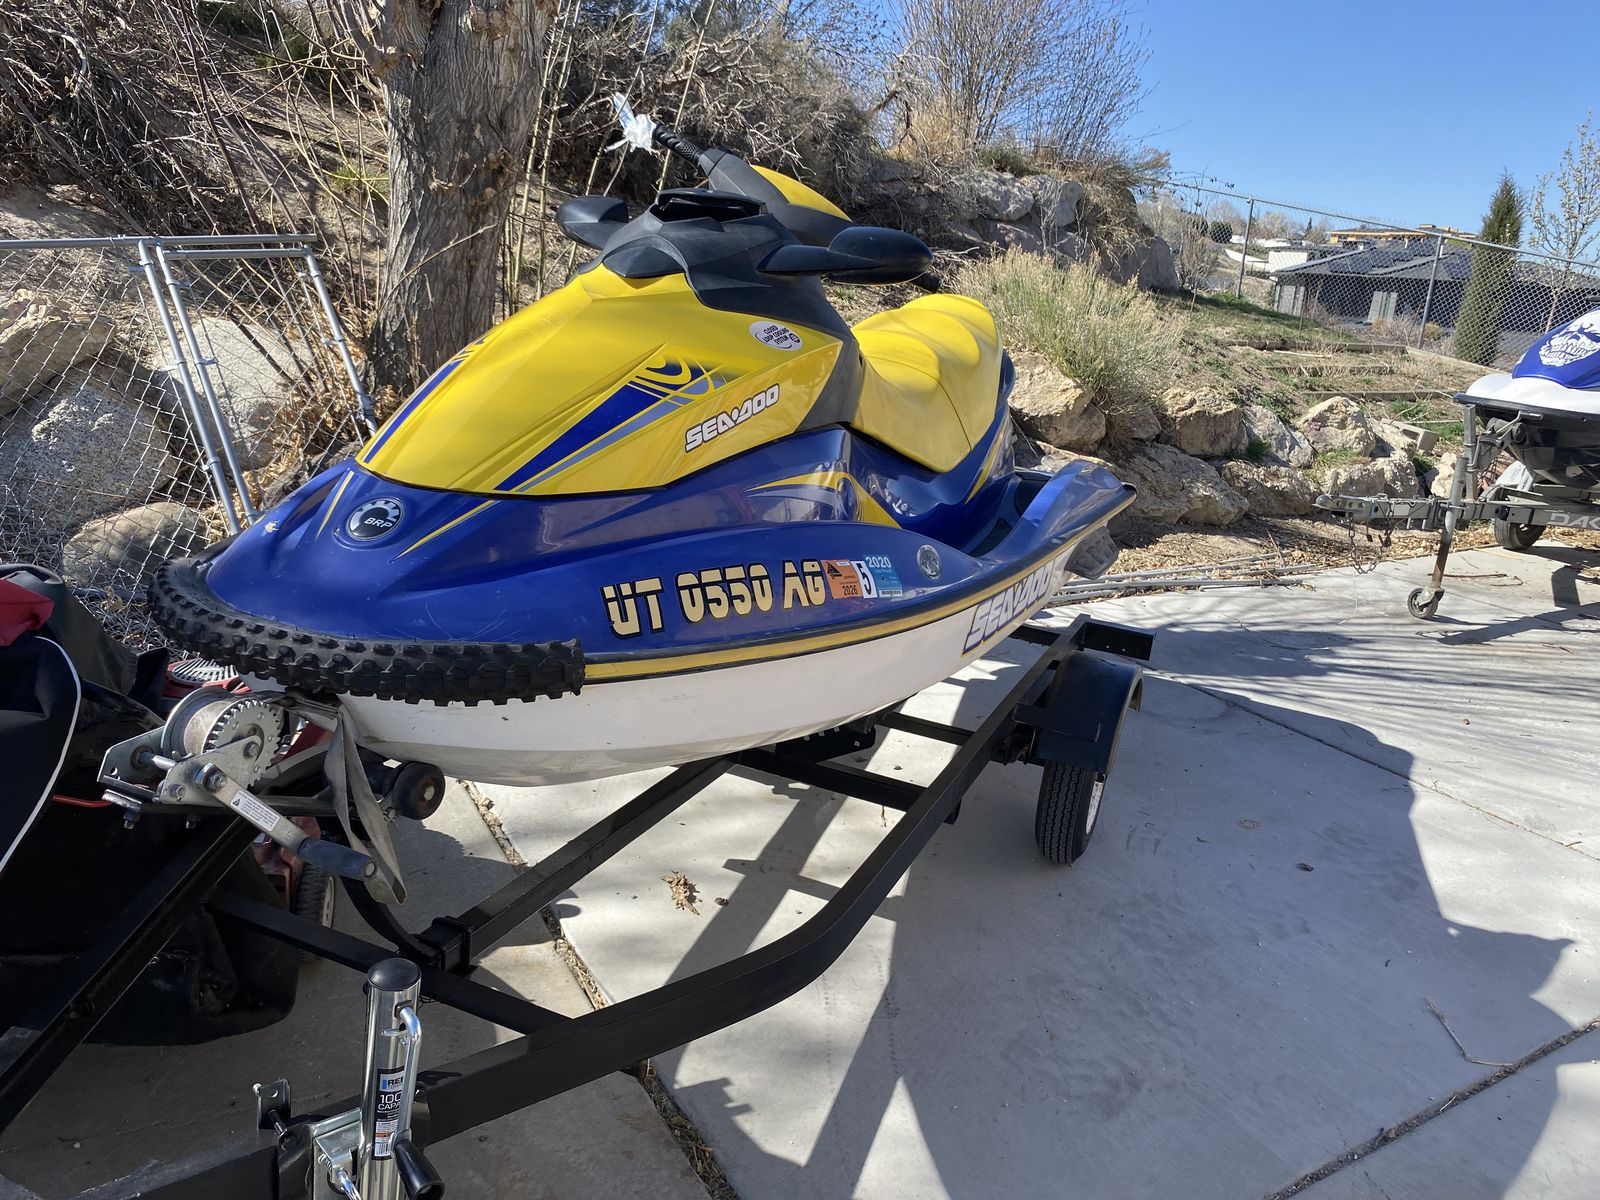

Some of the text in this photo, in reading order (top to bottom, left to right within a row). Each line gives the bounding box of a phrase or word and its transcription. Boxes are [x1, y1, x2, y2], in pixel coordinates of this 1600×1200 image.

[364, 517, 393, 528] BRP
[866, 556, 892, 568] 2020
[856, 562, 872, 595] 5
[842, 585, 858, 596] 2026
[600, 576, 664, 640] UT
[675, 562, 774, 623] 0550
